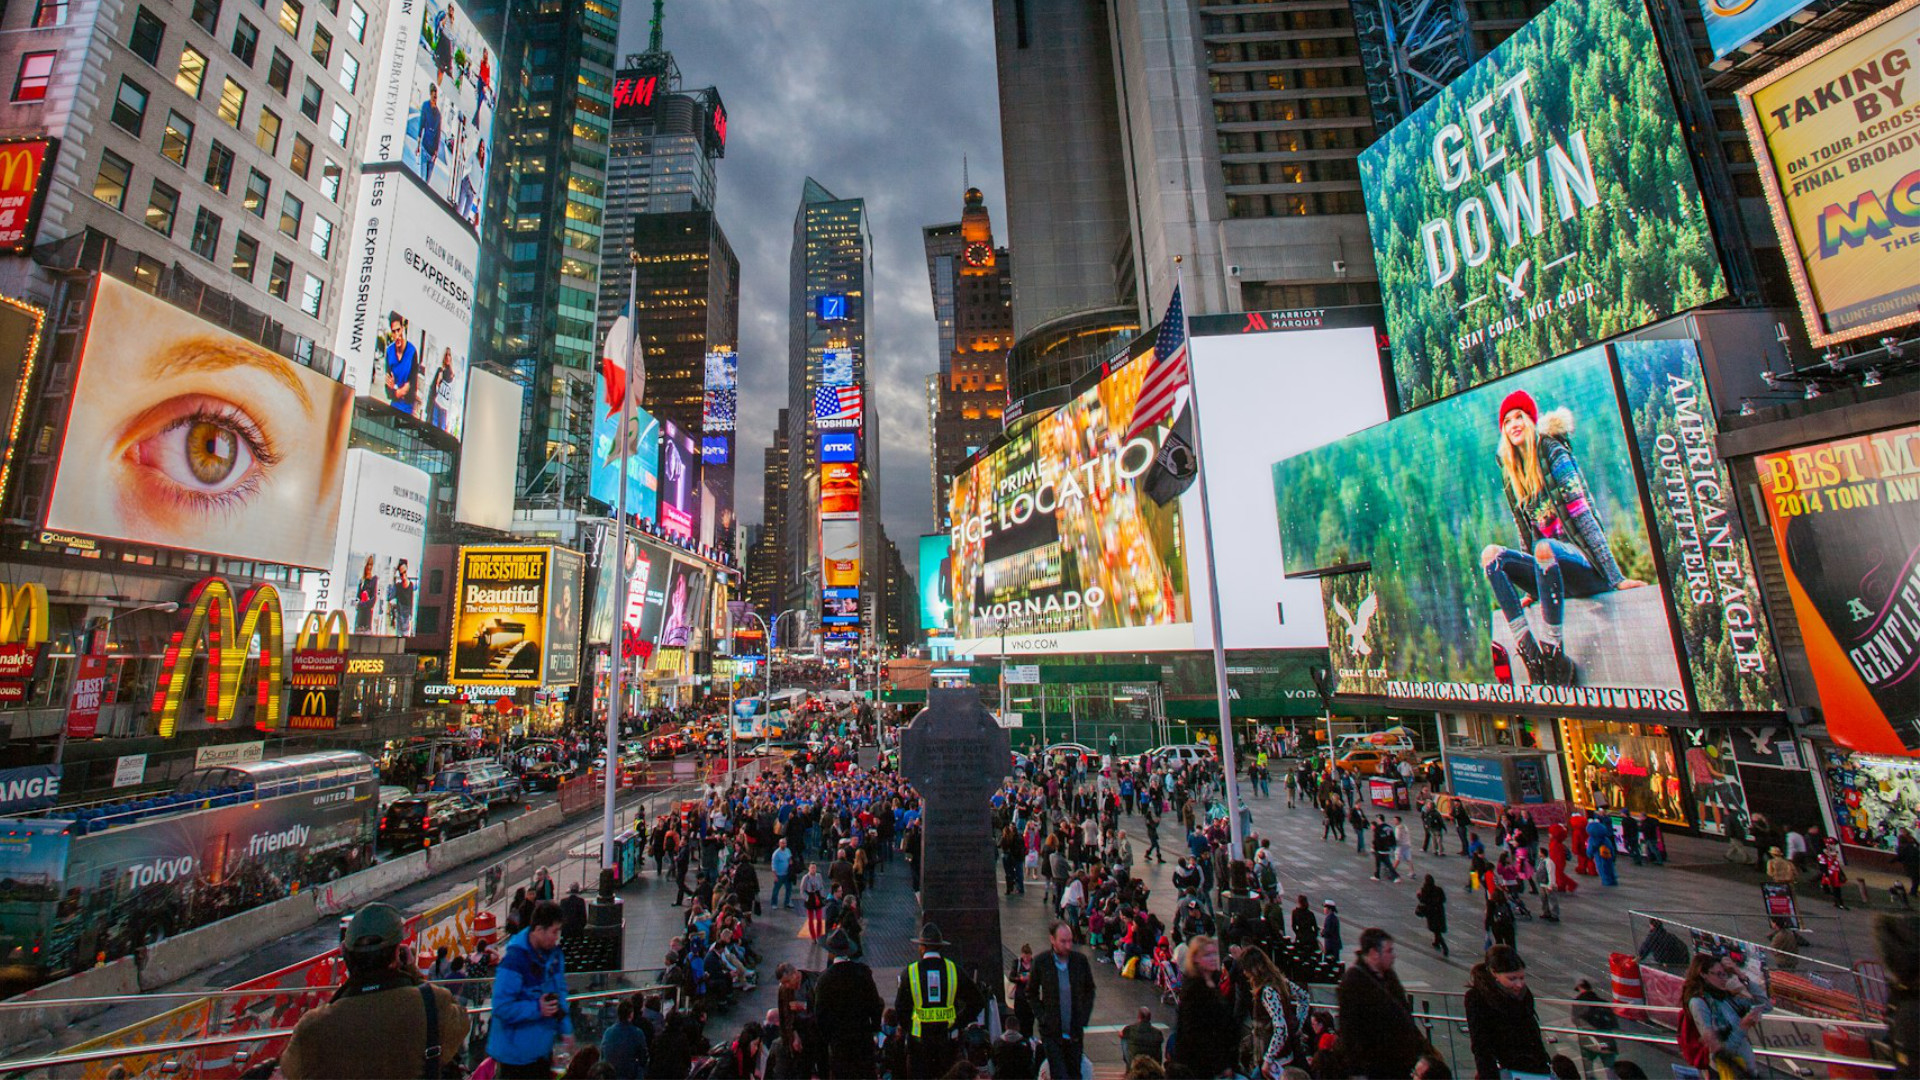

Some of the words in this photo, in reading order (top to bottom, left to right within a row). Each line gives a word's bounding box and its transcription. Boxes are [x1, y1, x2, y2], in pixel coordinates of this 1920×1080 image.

[1770, 48, 1911, 130] TAKING
[1852, 77, 1907, 123] BY
[1432, 69, 1535, 192] GET
[1787, 155, 1808, 175] ON
[1810, 136, 1853, 167] TOUR
[1792, 164, 1845, 197] FINAL
[1421, 129, 1600, 290] DOWN
[350, 217, 380, 353] @EXPRESSRUNWAY
[1271, 309, 1325, 319] MARRIOTT
[1272, 318, 1321, 328] MARQUIS
[1458, 329, 1485, 351] STAY
[1487, 312, 1524, 338] COOL.
[1528, 301, 1553, 324] NOT
[1558, 281, 1601, 311] COLD.
[816, 419, 859, 428] TOSHIBA
[830, 444, 852, 452] TDK
[1000, 456, 1048, 496] PRIME
[1765, 443, 1865, 494] BEST
[1775, 490, 1824, 518] 2014
[1824, 483, 1880, 511] TONY
[1655, 433, 1714, 605] OUTFITTERS
[1667, 372, 1735, 550] AMERICAN
[1712, 558, 1767, 673] EAGLE
[466, 584, 540, 604] Beautiful
[466, 604, 477, 613] The
[498, 604, 513, 615] King
[514, 604, 538, 613] Musical
[979, 587, 1105, 624] VORNADO
[1847, 597, 1874, 622] A
[294, 656, 344, 664] McDonald's
[1012, 639, 1058, 649] VNO.COM
[74, 677, 104, 694] JERSEY
[1339, 668, 1363, 678] GREAT
[1368, 668, 1388, 679] GIFT
[77, 693, 100, 709] BOYS
[424, 685, 456, 694] GIFTS
[464, 686, 516, 696] LUGGAGE
[1387, 681, 1470, 700] AMERICAN
[1476, 683, 1535, 704] EAGLE
[1539, 685, 1688, 711] OUTFITTERS
[313, 791, 346, 805] UNITED
[250, 824, 310, 856] friendly
[129, 856, 193, 890] Tokyo
